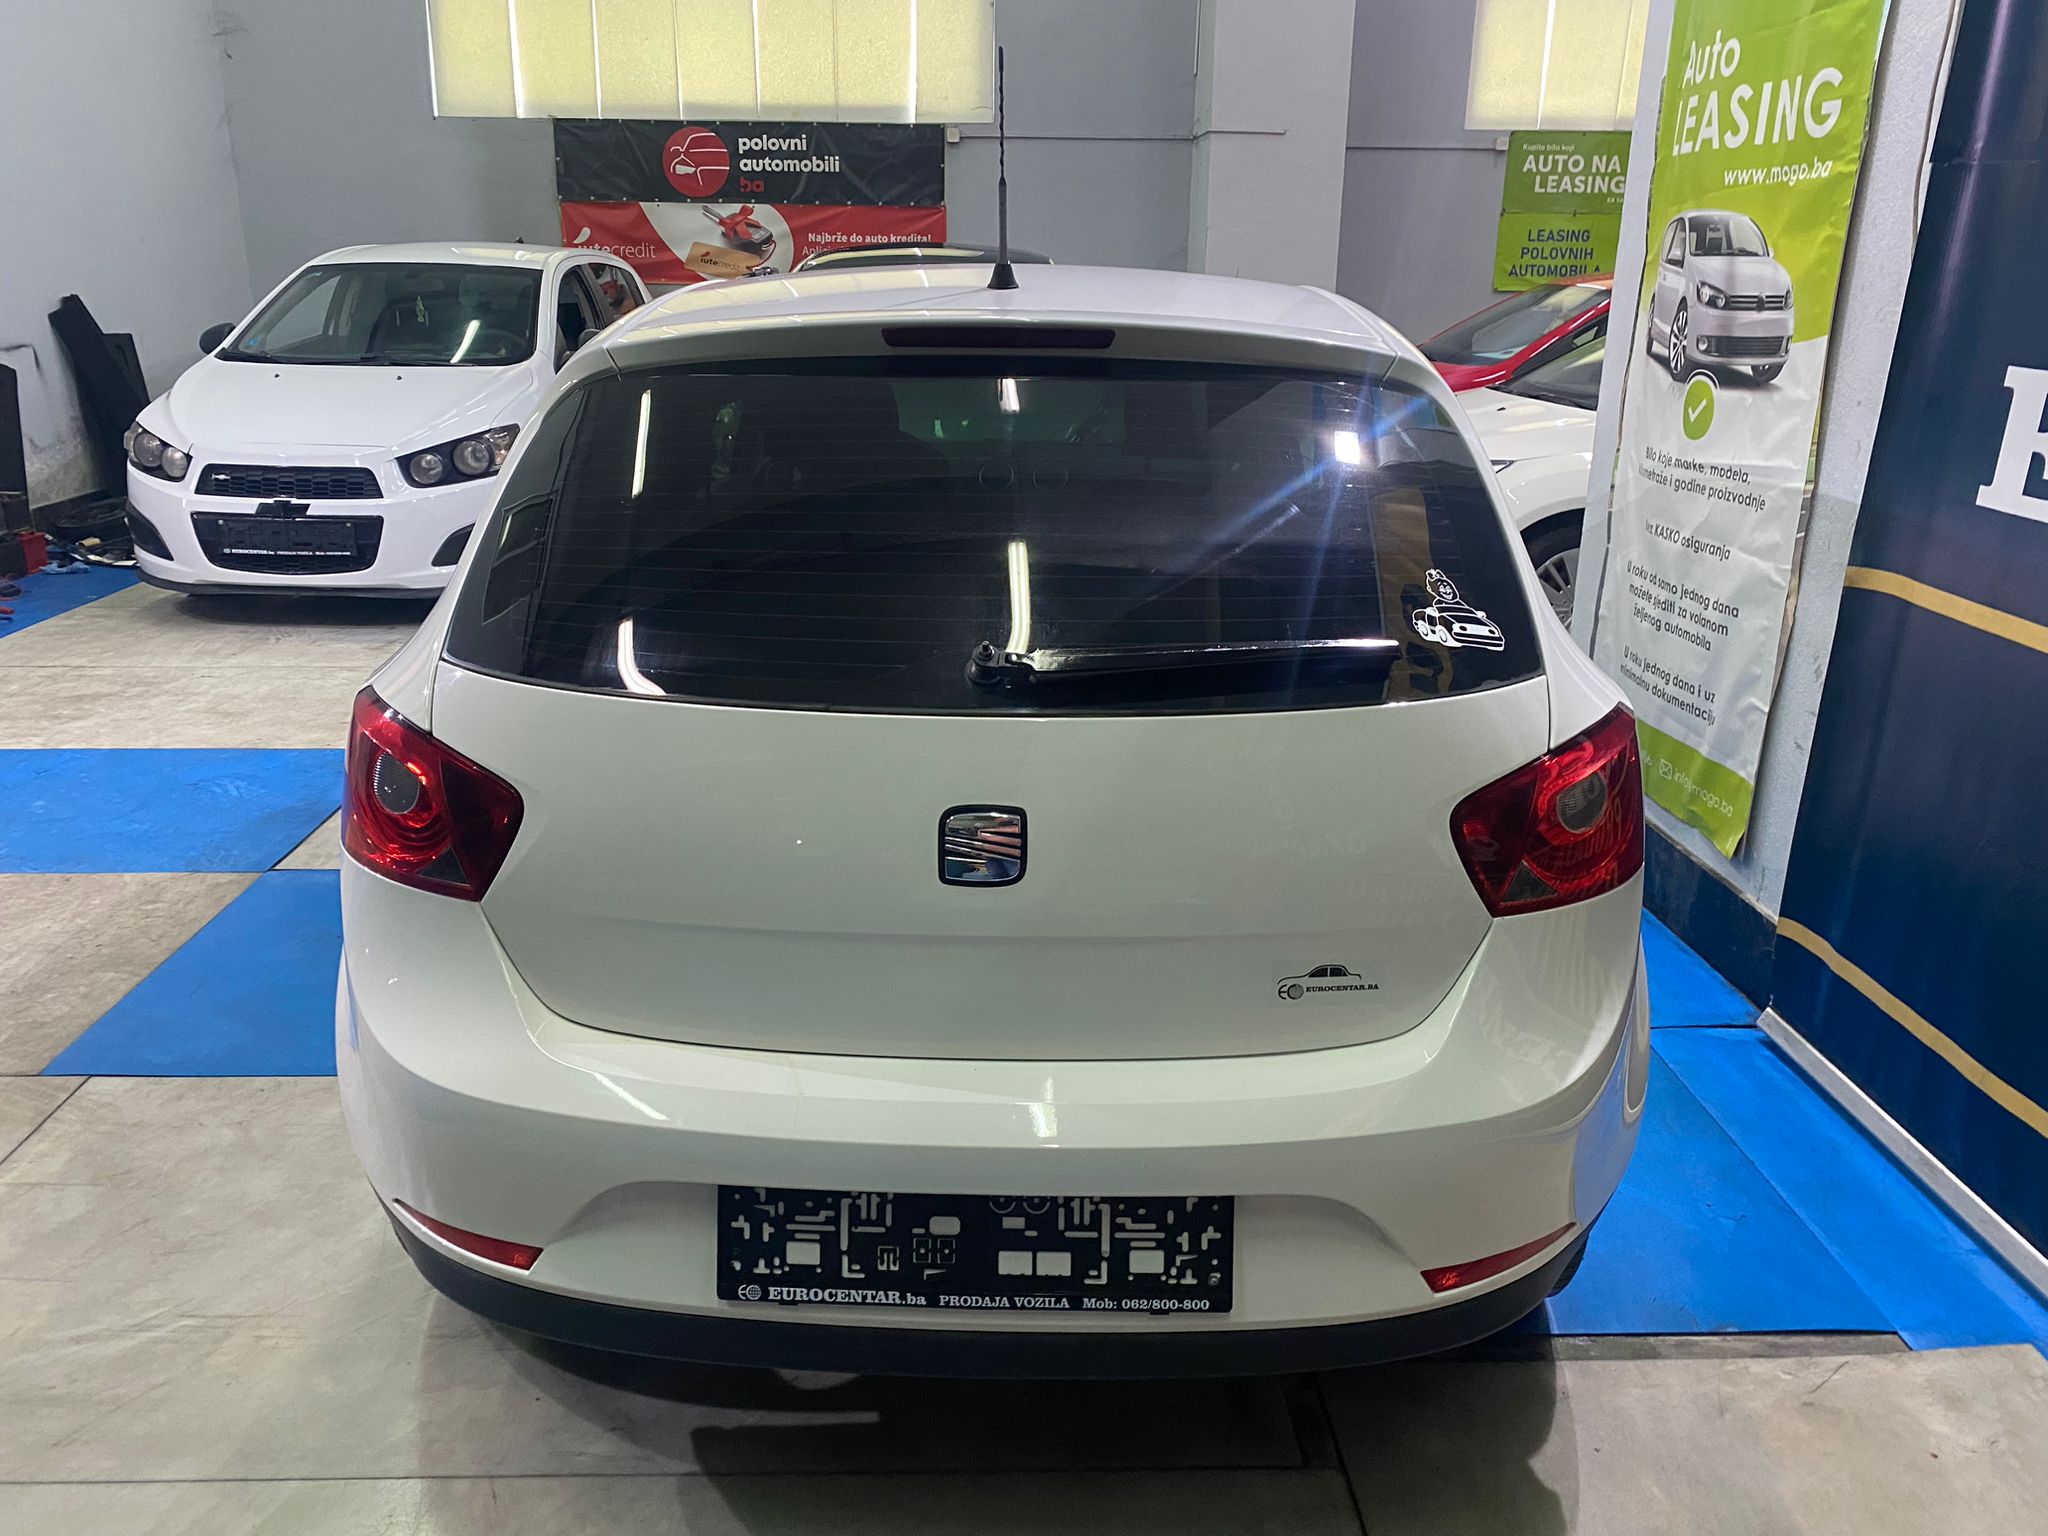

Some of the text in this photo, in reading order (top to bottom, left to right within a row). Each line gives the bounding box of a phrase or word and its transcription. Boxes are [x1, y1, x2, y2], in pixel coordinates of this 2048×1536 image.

[1682, 30, 1741, 89] Auto
[1672, 67, 1843, 157] LEASING
[738, 134, 807, 154] polovni
[740, 155, 839, 172] automobili
[1522, 154, 1620, 173] AUTO NA
[1724, 157, 1833, 187] www.mogo.ba
[1534, 175, 1625, 194] LEASING
[808, 232, 931, 244] Najbrže do auto kredita!
[1527, 229, 1591, 243] LEASING
[1520, 247, 1594, 260] POLOVNIH
[1674, 458, 1707, 476] marke,
[1710, 464, 1751, 485] modela,
[1674, 478, 1707, 495] godine
[1708, 486, 1766, 512] proizvodnje
[1653, 523, 1680, 544] KASKO
[1681, 535, 1731, 561] osiguranja
[1631, 566, 1649, 580] roku
[1658, 578, 1678, 595] samo
[1679, 583, 1710, 611] jednog
[1712, 598, 1739, 618] dana
[1628, 583, 1653, 604] možete
[1677, 605, 1688, 619] za
[1689, 611, 1729, 636] volanom
[1633, 602, 1711, 651] željenog automobila
[1630, 651, 1642, 668] roku
[1642, 657, 1671, 686] jednog
[1672, 674, 1696, 696] dana
[1697, 684, 1702, 698] i
[1704, 690, 1716, 704] uz
[1620, 664, 1716, 727] minimalnu dokumentaciju
[1305, 984, 1379, 993] EUROCENTAR.BA
[768, 1286, 927, 1306] EUROCENTAR.ba
[939, 1294, 1010, 1308] PRODAJA
[1013, 1296, 1071, 1309] VOZILA
[1082, 1297, 1118, 1310] Mob:
[1121, 1298, 1211, 1311] 062/800-800
